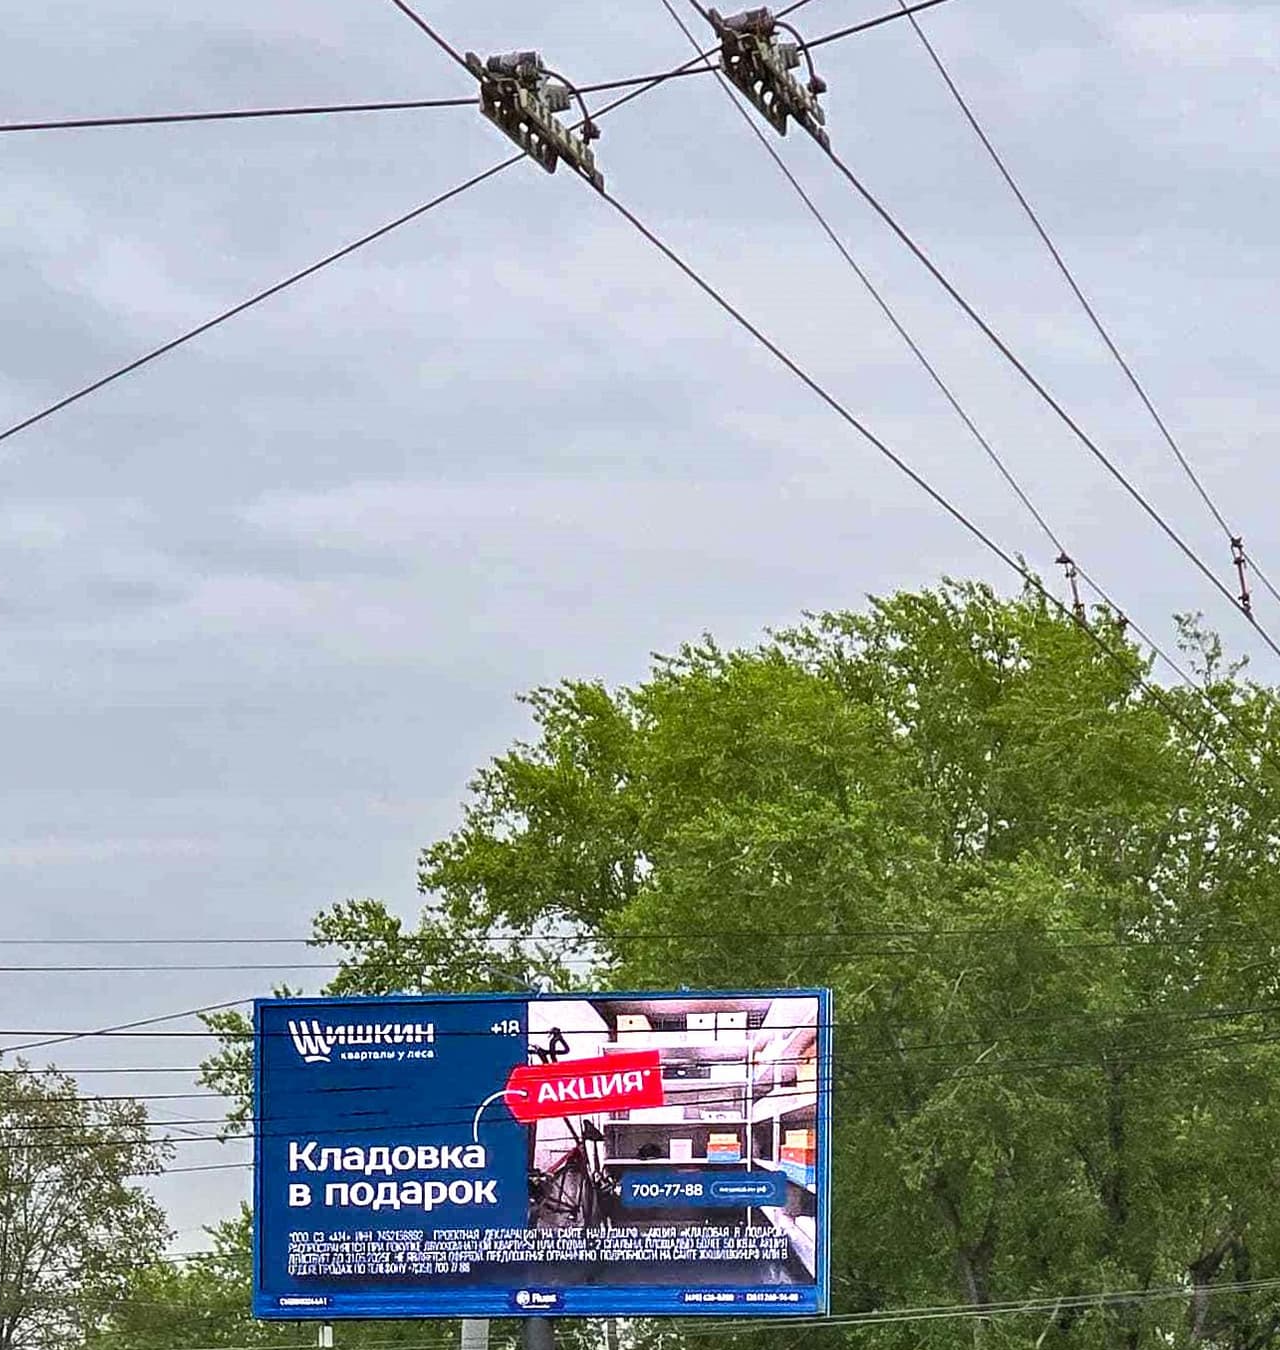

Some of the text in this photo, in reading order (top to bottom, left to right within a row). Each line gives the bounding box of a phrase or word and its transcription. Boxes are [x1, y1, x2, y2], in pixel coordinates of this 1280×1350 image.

[340, 1049, 435, 1061] кварталы у леса
[288, 1141, 486, 1175] Кладовка
[288, 1180, 497, 1211] в подарок
[631, 1183, 703, 1198] 700-77-88
